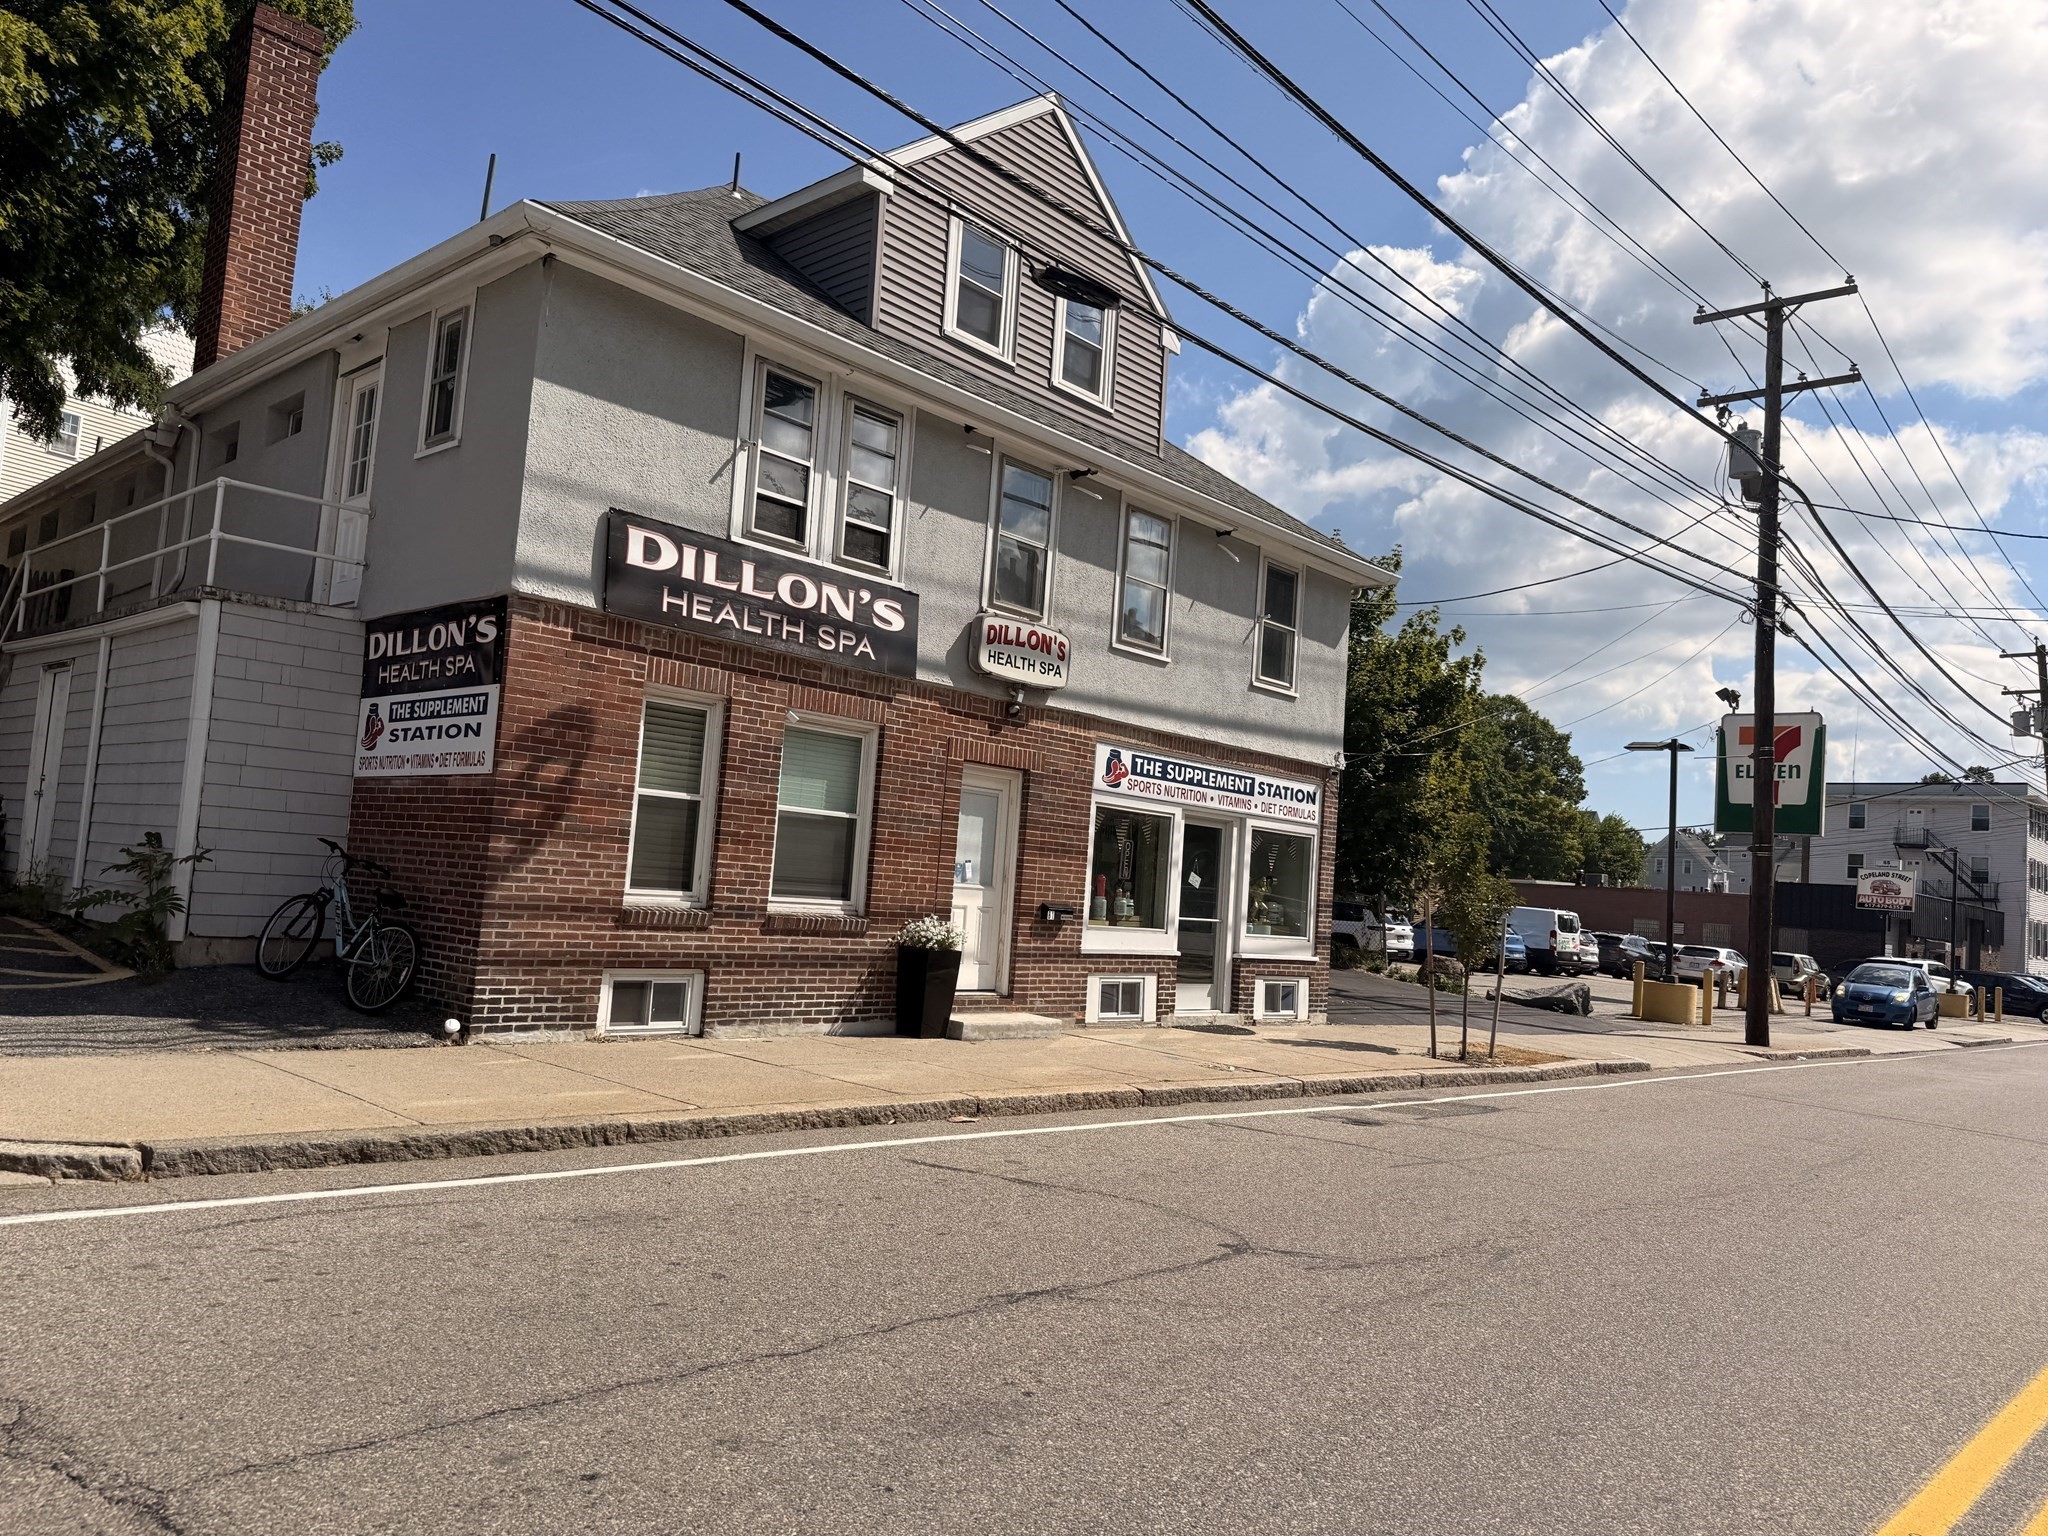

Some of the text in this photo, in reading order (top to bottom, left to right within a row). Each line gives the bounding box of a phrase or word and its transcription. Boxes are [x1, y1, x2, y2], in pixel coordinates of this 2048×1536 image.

[625, 524, 906, 632] DILLON'S
[368, 614, 498, 661] DILLON'S
[662, 586, 877, 660] HEALTH SPA
[986, 625, 1066, 662] DILLON'S
[378, 654, 476, 684] HEALTH SPA
[988, 650, 1062, 678] HEALTH SPA
[392, 696, 486, 720] THE SUPPLEMENT
[389, 722, 481, 742] STATION
[359, 751, 486, 771] SPORTS NUTRITION VITAMINS DIET FORMULAS
[1135, 758, 1317, 805] THE SUPPLEMENT STATION
[1127, 778, 1316, 821] SPORTS NUTRITION VITAMINS DIET FORMULAS
[1860, 872, 1912, 882] COPELAND STREET
[1885, 897, 1911, 905] BODY
